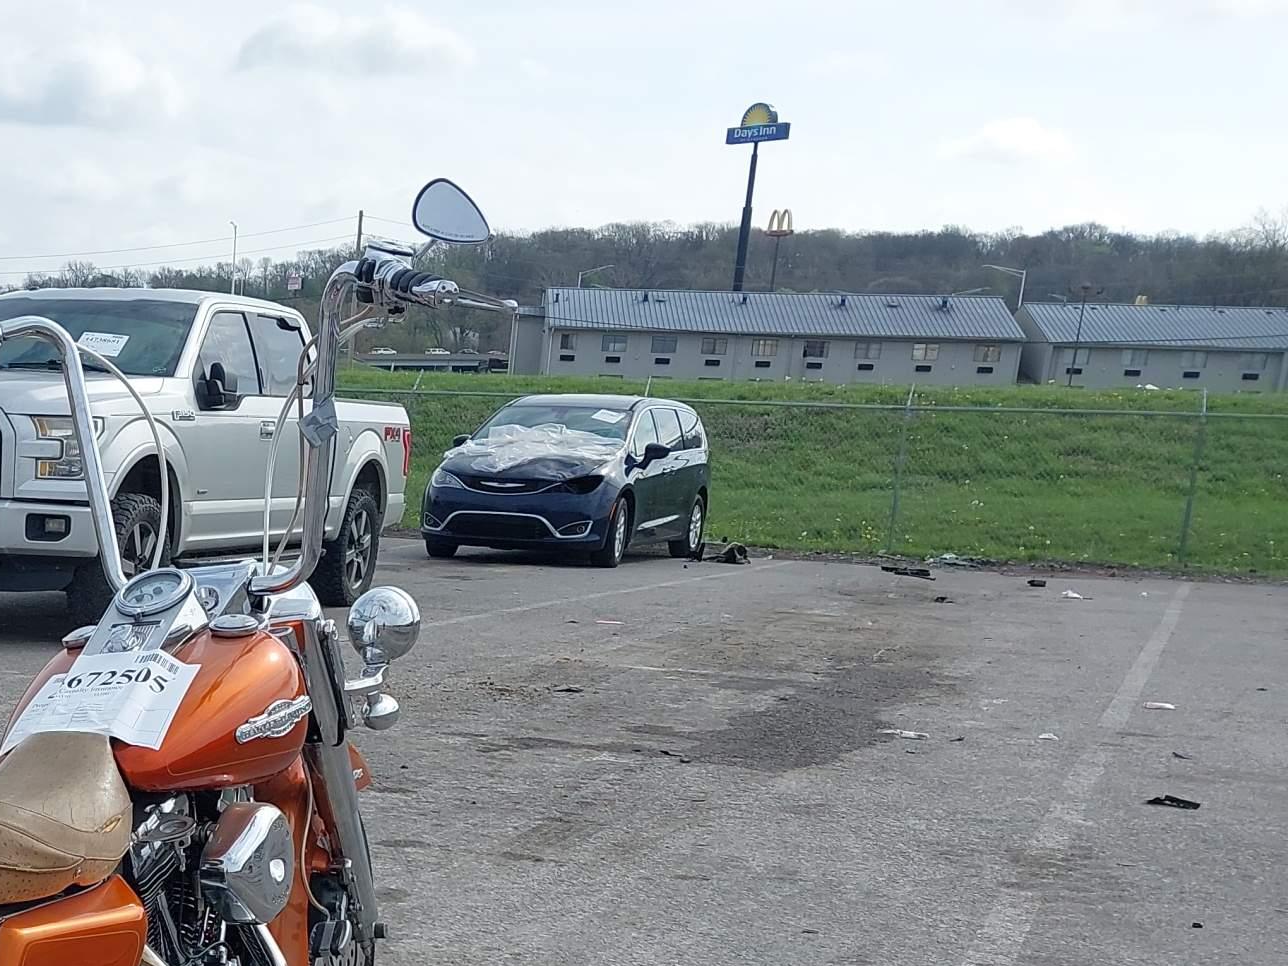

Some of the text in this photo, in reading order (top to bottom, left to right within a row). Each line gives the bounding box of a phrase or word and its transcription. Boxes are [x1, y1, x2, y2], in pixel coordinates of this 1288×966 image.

[734, 126, 776, 138] Days Inn
[385, 427, 400, 442] FX4
